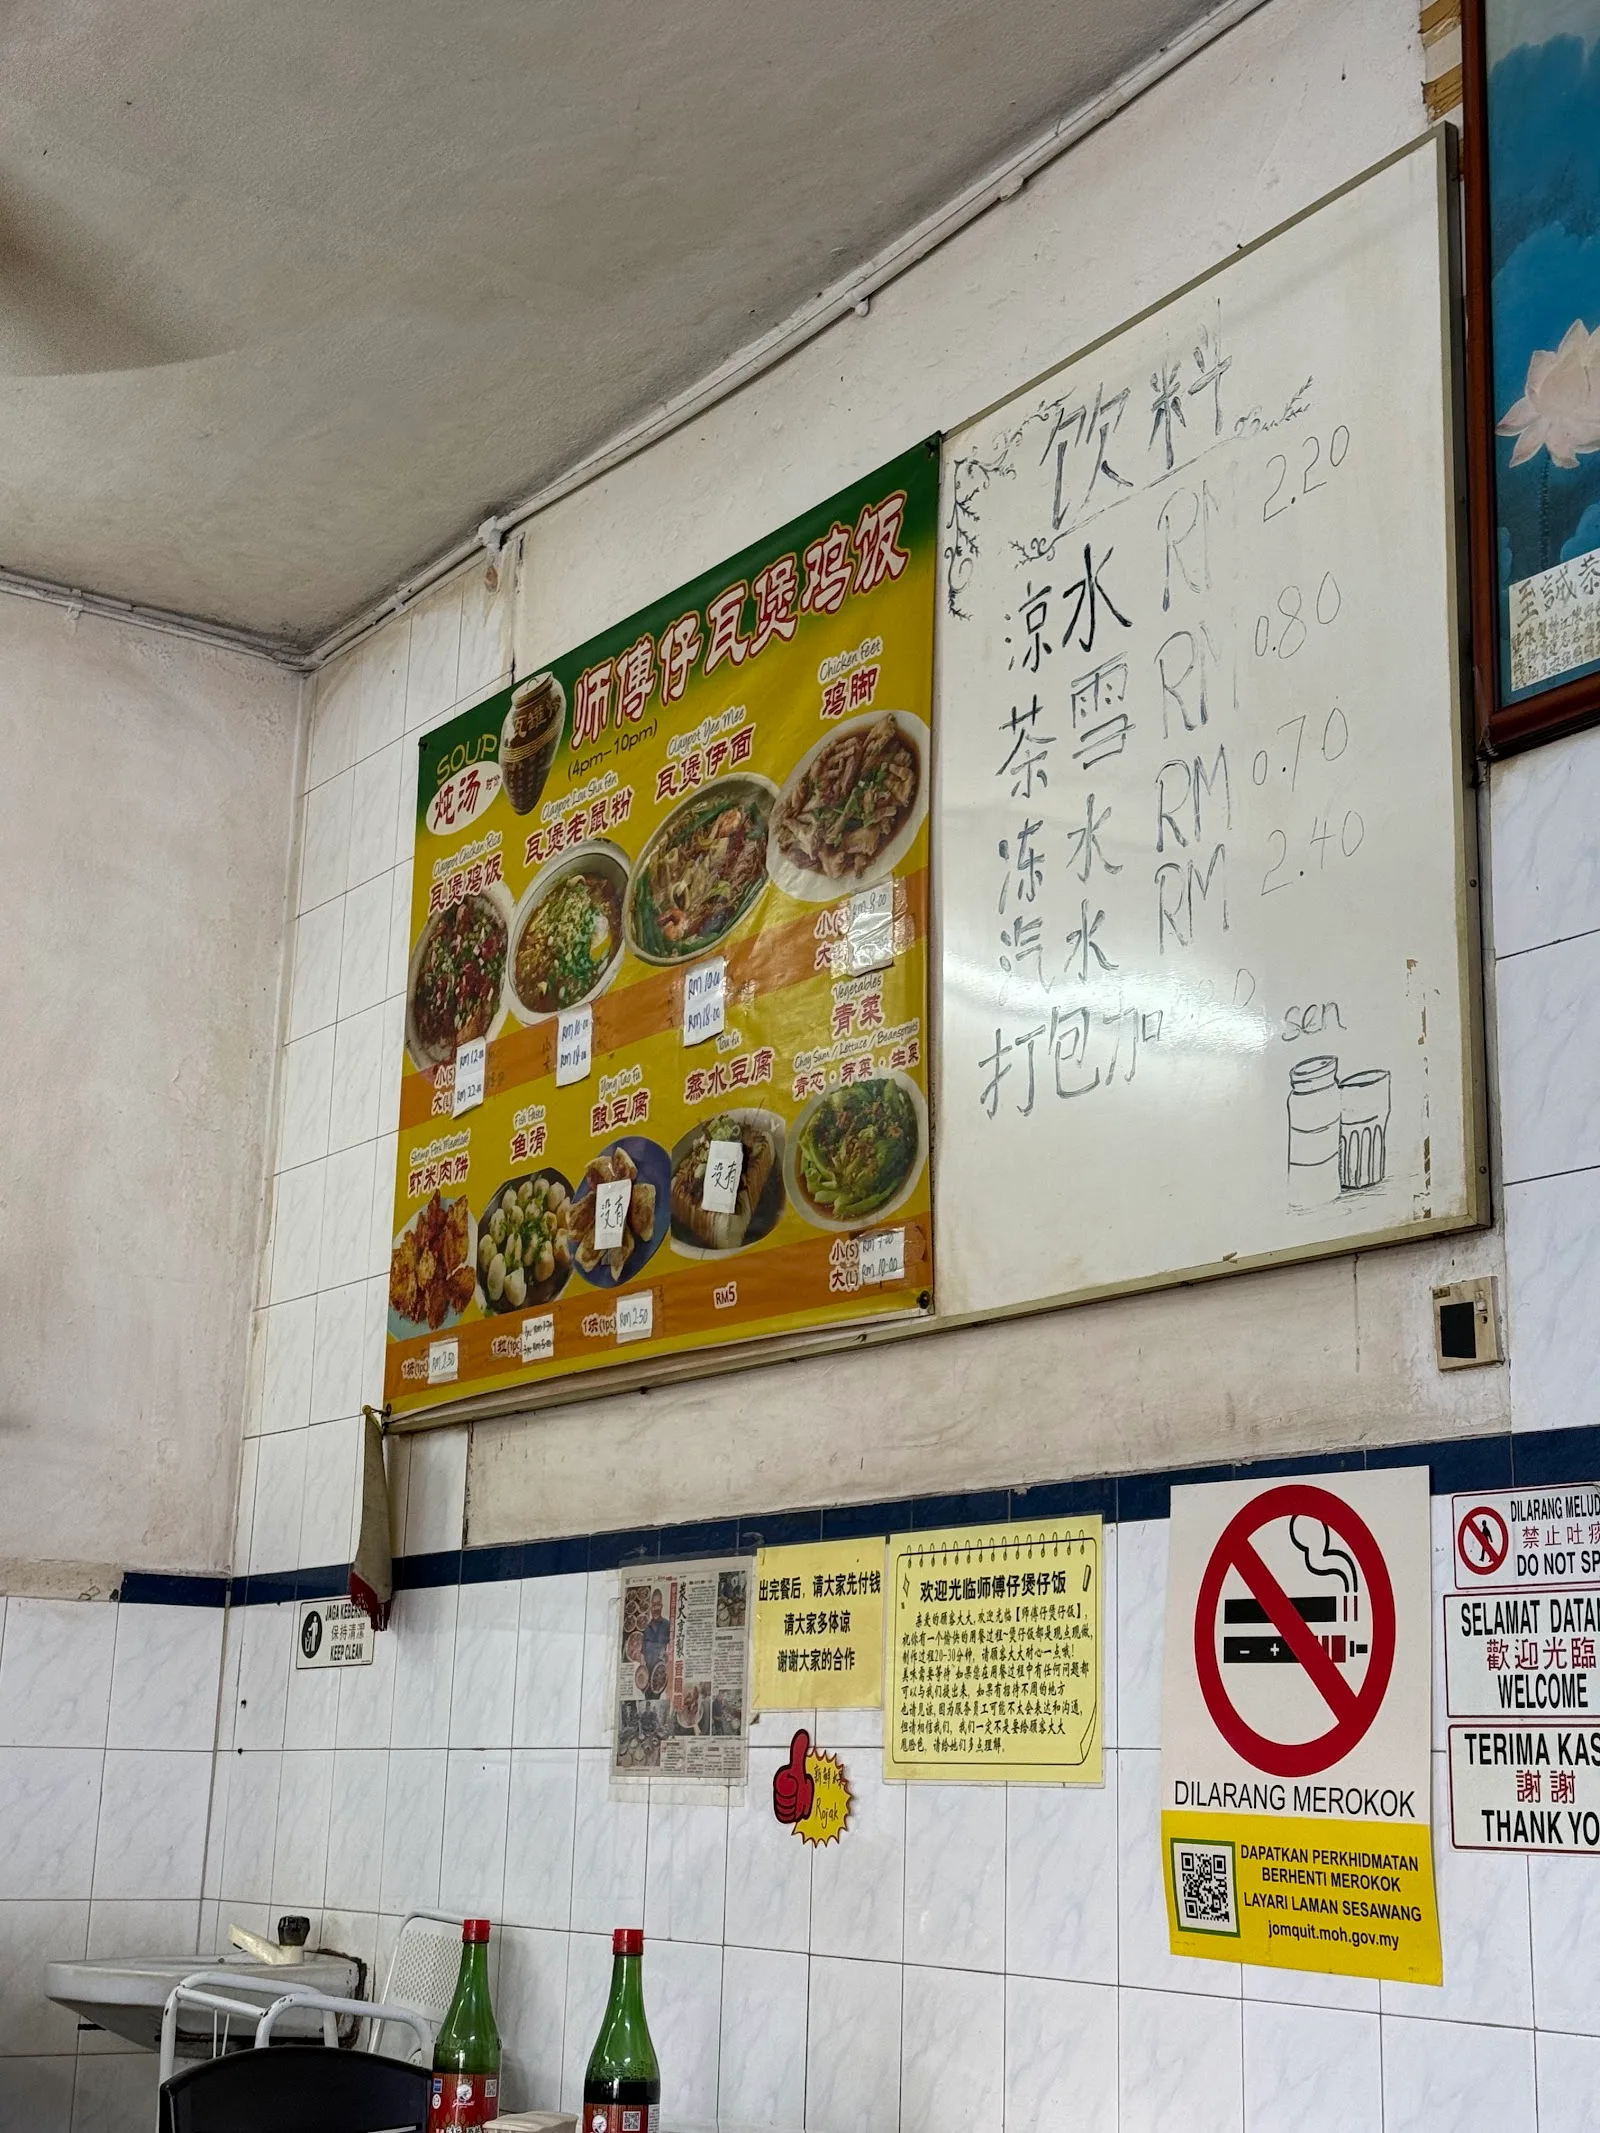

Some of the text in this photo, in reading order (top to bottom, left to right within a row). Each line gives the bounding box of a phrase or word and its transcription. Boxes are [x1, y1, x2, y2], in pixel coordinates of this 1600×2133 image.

[1263, 425, 1350, 523] 2.20
[572, 490, 911, 751] 师傅仔瓦煲鸡饭
[1254, 570, 1342, 660] 0.80
[820, 639, 881, 681] Chicken Feet
[821, 667, 878, 716] 鸡脚
[701, 719, 720, 746] Yee
[722, 707, 745, 728] Mee
[437, 733, 497, 786] SOUP
[655, 725, 754, 801] 瓦煲伊面
[604, 772, 618, 789] Fen
[1155, 744, 1232, 854] RM
[1252, 706, 1349, 792] 0.70
[433, 769, 480, 830] 炖汤
[486, 832, 502, 849] Rice
[525, 788, 633, 865] 瓦煲老鼠粉
[428, 852, 502, 913] 瓦煲鸡饭
[999, 810, 1365, 1004] 汽水 RM 2.40
[832, 976, 881, 1000] Vegetables
[832, 993, 883, 1037] 青菜
[1282, 1002, 1347, 1042] sen
[839, 1038, 868, 1055] Lettuce
[600, 1077, 618, 1100] Yong
[685, 1049, 773, 1101] 蒸水豆腐
[591, 1091, 648, 1133] 酿豆腐
[511, 1126, 546, 1161] 鱼滑
[408, 1153, 469, 1195] 虾米肉饼
[831, 1242, 859, 1262] 小(S)
[715, 1285, 736, 1306] RM5
[831, 1269, 859, 1288] 大(L)
[1511, 1498, 1562, 1523] DILARANG
[1517, 1550, 1600, 1577] DO NOT SP
[919, 1570, 1066, 1603] 欢迎光临师傅仔煲仔饭
[325, 1604, 340, 1621] JAGA
[783, 1609, 851, 1636] 请大家多体谅
[1460, 1597, 1600, 1637] SELAMAT DATA
[331, 1622, 365, 1641] 保持清潔
[330, 1643, 364, 1661] KEEP CLEAN
[777, 1646, 856, 1672] 谢谢大家的合作
[1486, 1636, 1597, 1672] 歡迎光臨
[1497, 1673, 1589, 1709] WELCOME
[1464, 1731, 1600, 1766] TERIMA KAS
[1174, 1780, 1416, 1819] DILARANG MEROKOK
[1516, 1768, 1576, 1804] 謝謝
[815, 1798, 839, 1829] Rojak
[1481, 1810, 1600, 1846] THANK YO
[1240, 1844, 1419, 1873] DAPATKAN PERKHIDMATAN
[1262, 1866, 1401, 1893] BERHENTI MEROKOK
[1243, 1891, 1422, 1923] LAYARI LAMAN SESAWANG
[1268, 1920, 1400, 1950] jomquit.moh.gov.my
